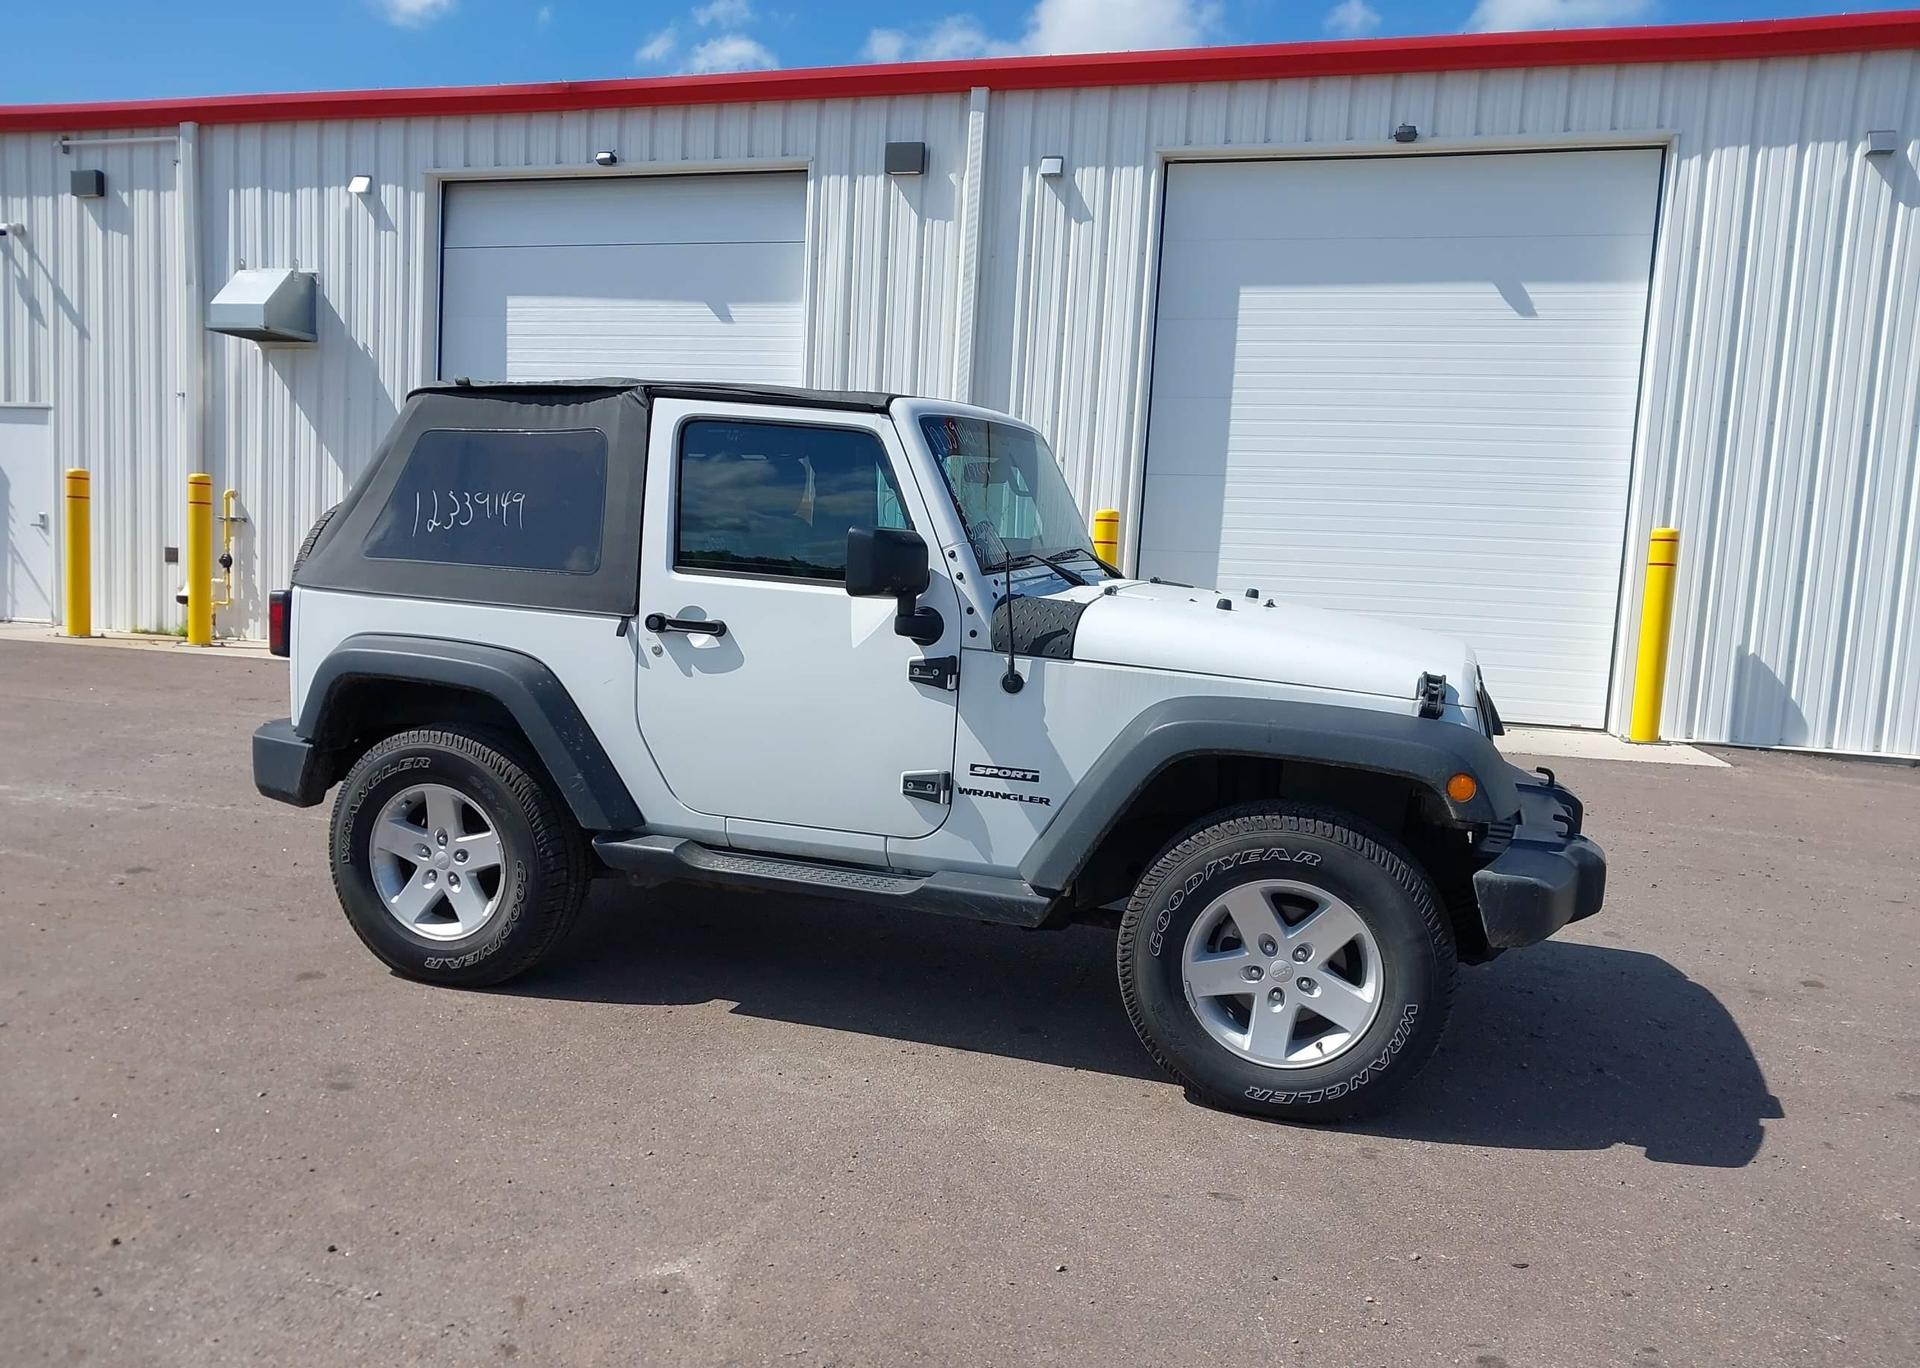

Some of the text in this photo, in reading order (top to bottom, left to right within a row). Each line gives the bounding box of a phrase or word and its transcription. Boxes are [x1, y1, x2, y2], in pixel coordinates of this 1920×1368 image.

[412, 489, 526, 537] 12339149
[341, 756, 432, 865] WRANGLER
[957, 787, 1051, 807] WRANGLER
[972, 765, 1037, 780] SPORT
[424, 859, 528, 969] GOODYEAR
[1150, 847, 1322, 957] GOODYEAR
[1245, 1003, 1419, 1104] WRANGLER
